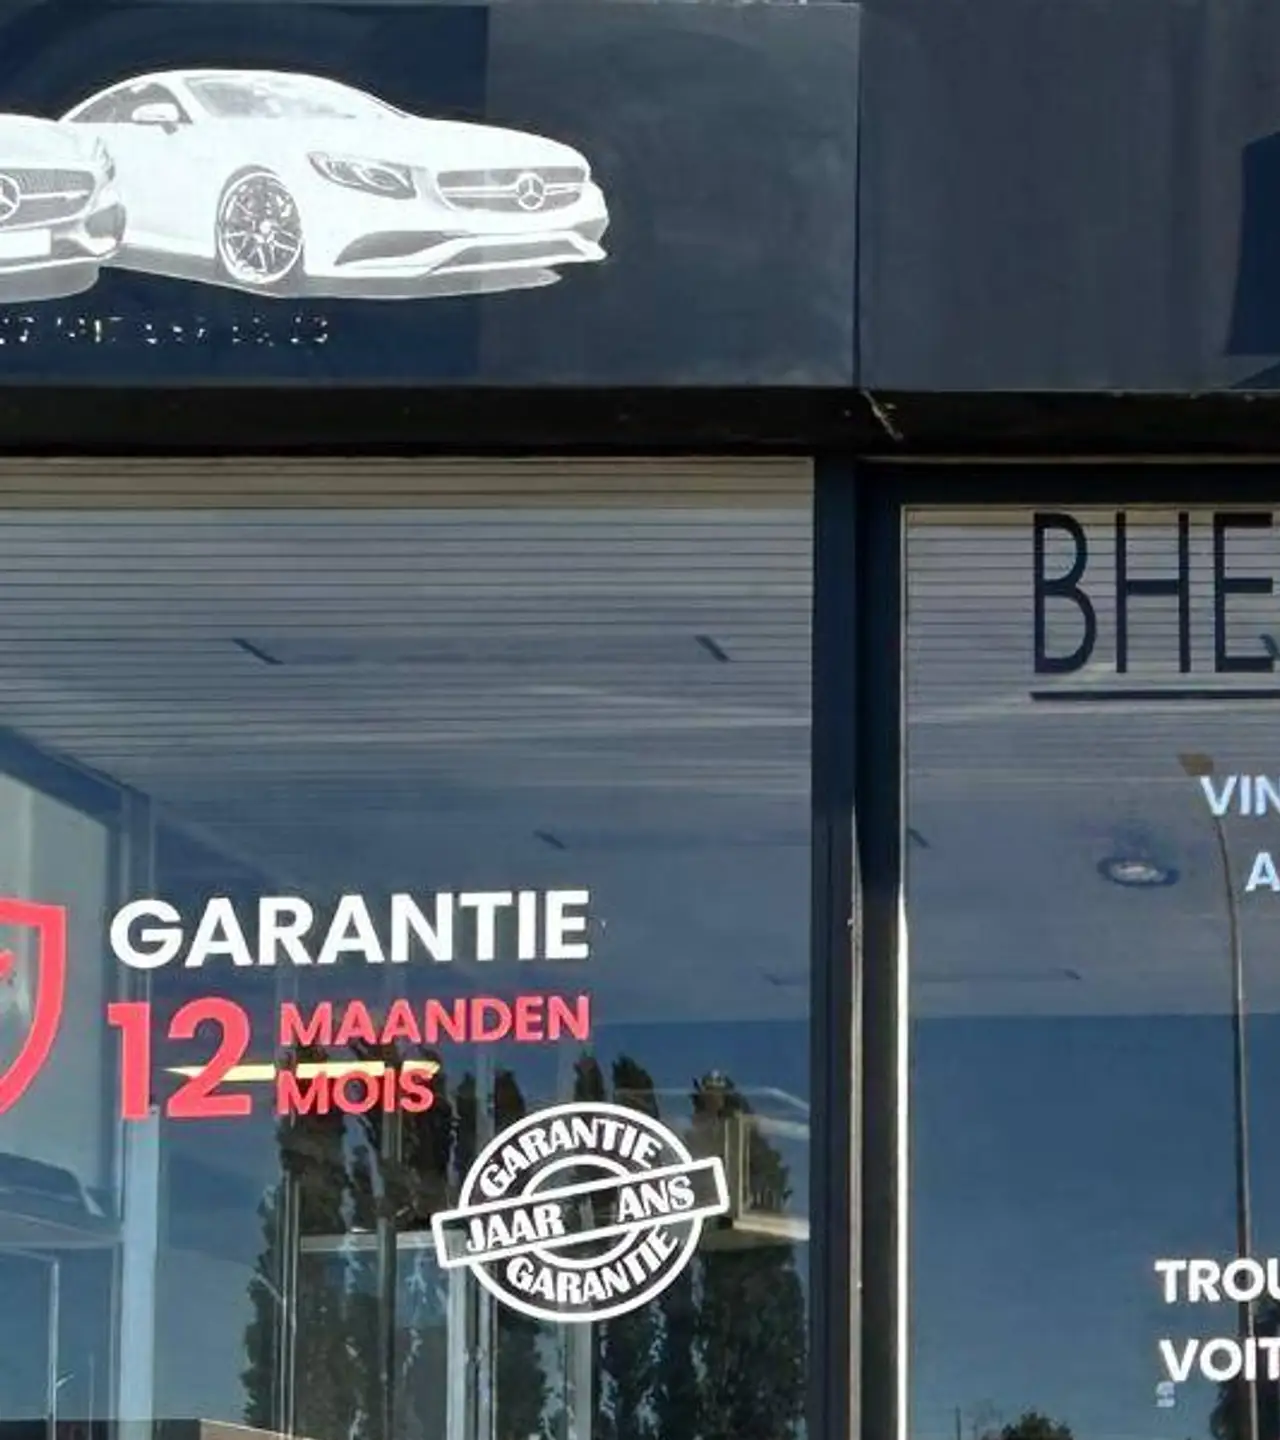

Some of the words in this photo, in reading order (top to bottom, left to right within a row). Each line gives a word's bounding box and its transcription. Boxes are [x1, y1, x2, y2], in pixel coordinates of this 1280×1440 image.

[109, 889, 590, 969] GARANTIE
[106, 996, 253, 1120] 12
[280, 995, 591, 1048] MAANDEN
[276, 1066, 434, 1117] MOIS
[479, 1116, 663, 1199] GARANTIE
[466, 1202, 566, 1252] JAAR
[616, 1174, 696, 1224] ANS
[505, 1223, 678, 1305] GARANTIE
